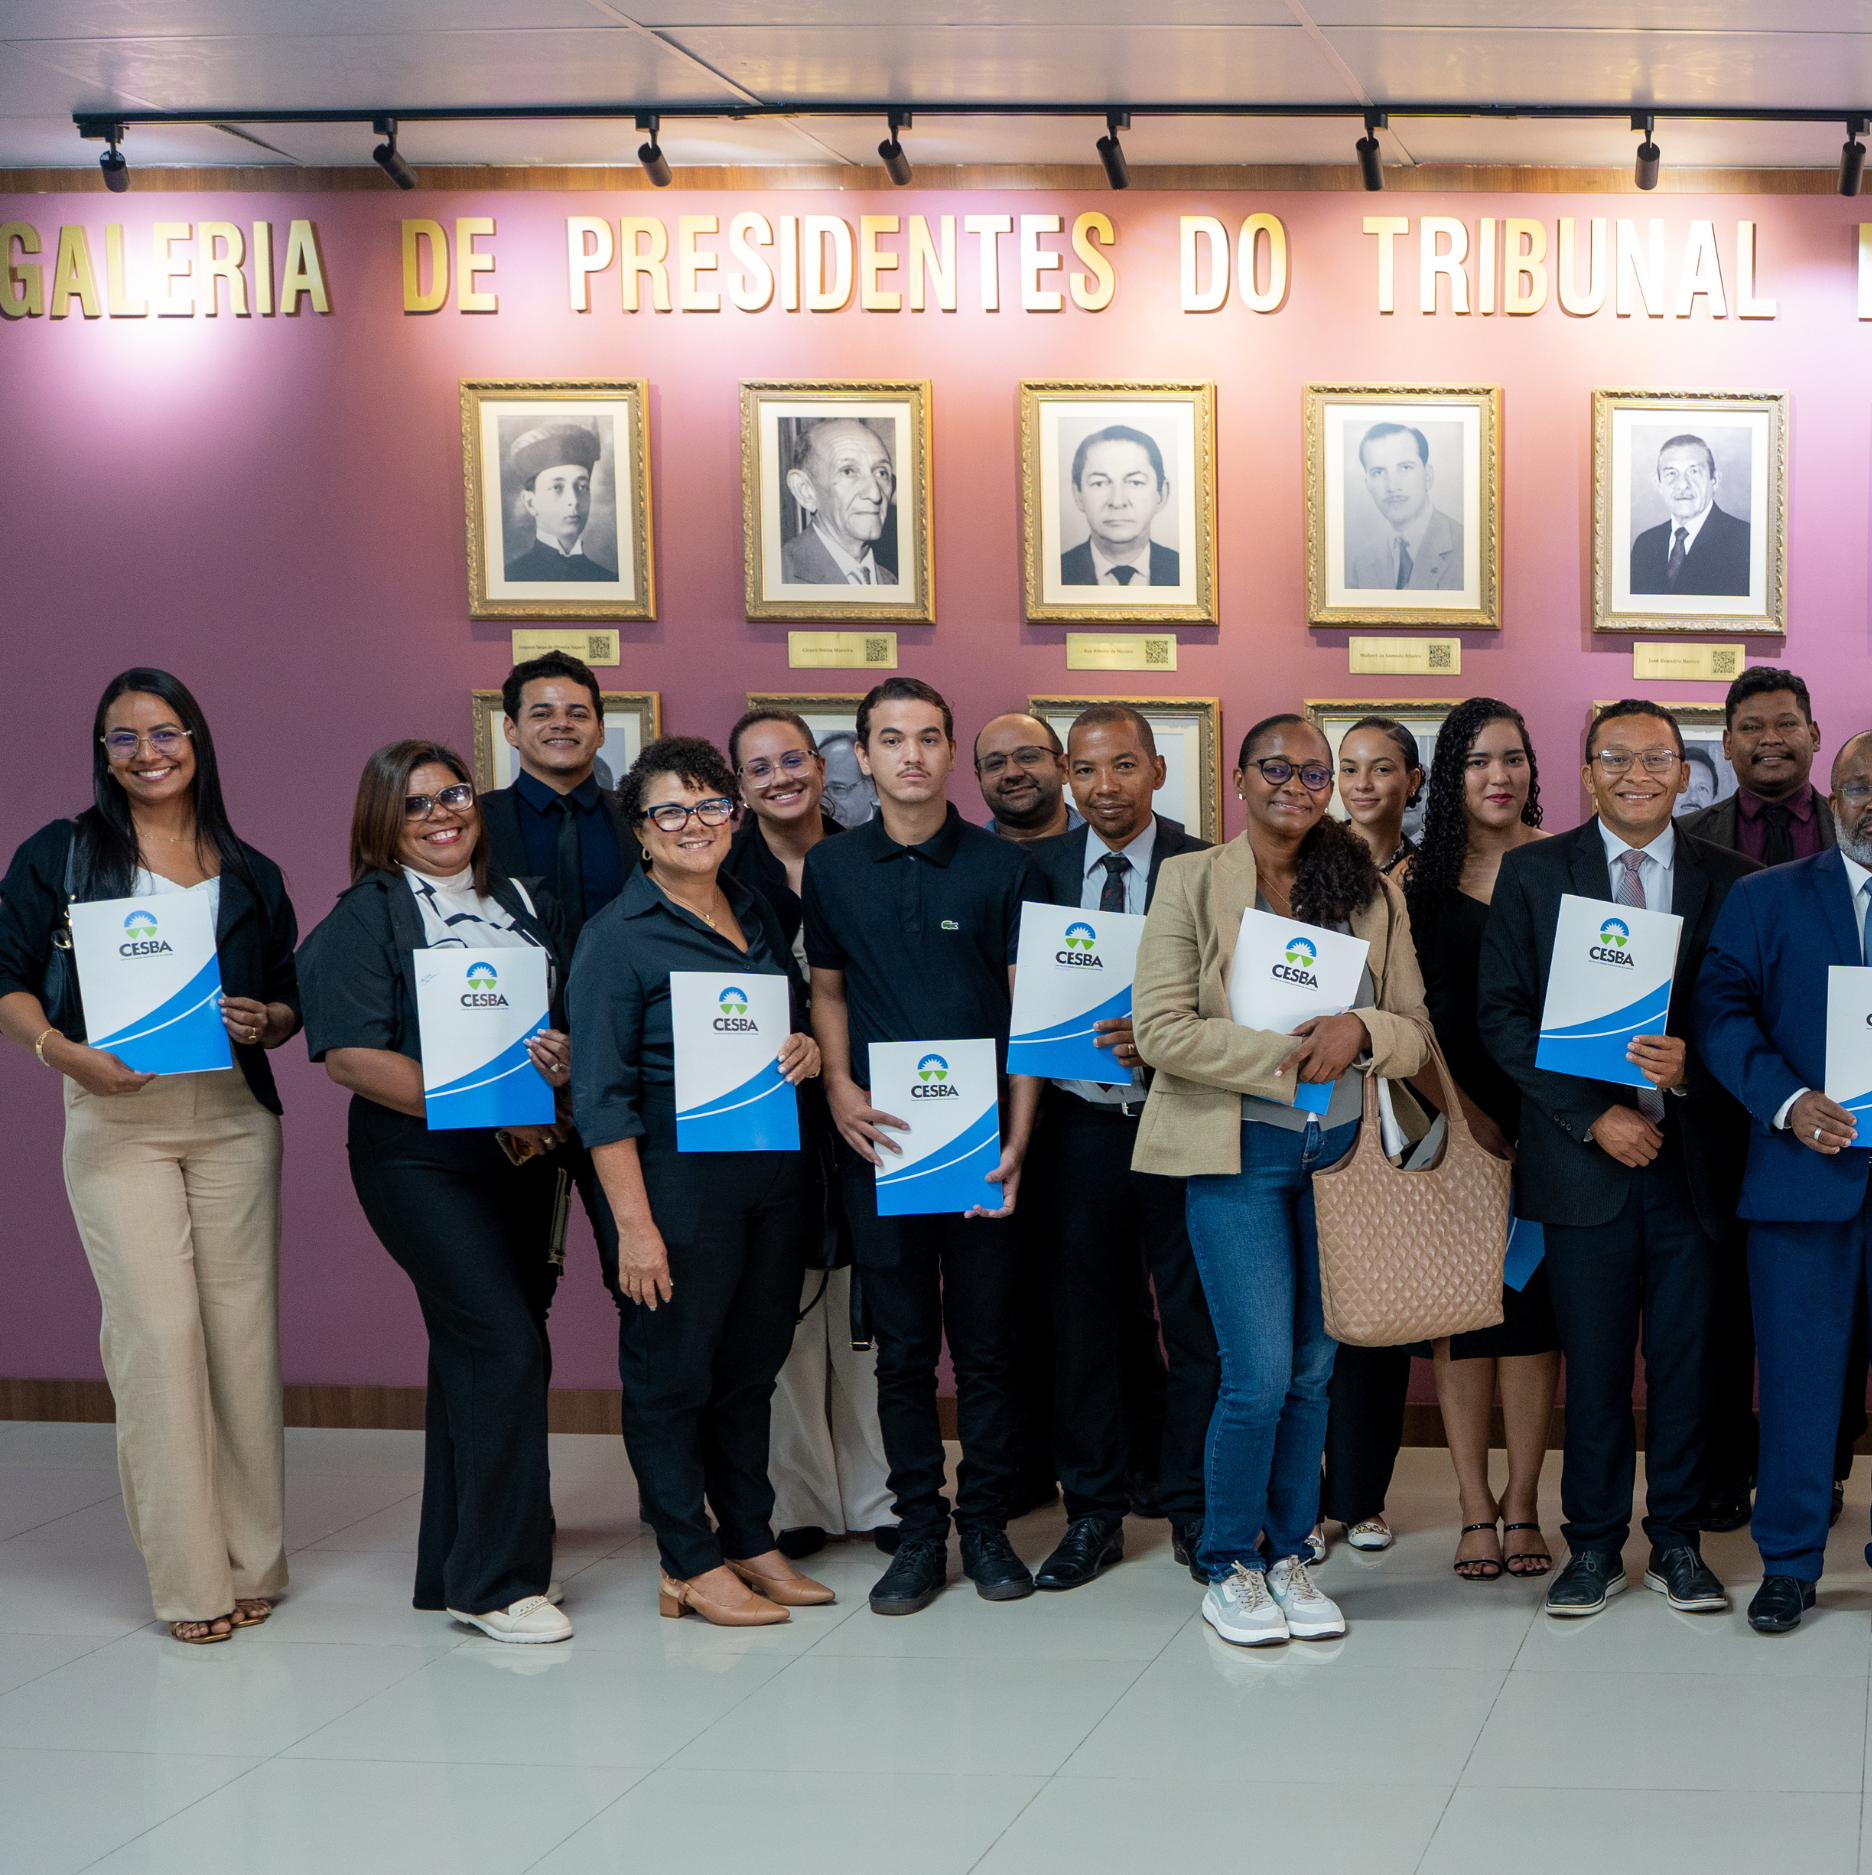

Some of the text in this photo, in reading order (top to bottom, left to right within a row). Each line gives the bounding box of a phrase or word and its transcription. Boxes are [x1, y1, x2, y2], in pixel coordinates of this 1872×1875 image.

[0, 219, 331, 318] GALERIA
[401, 217, 499, 316] DE
[566, 210, 1117, 314] PRESIDENTES
[1178, 212, 1291, 314] DO
[1362, 215, 1779, 320] TRIBUNAL
[119, 939, 173, 957] CESBA
[1589, 946, 1635, 967] CESBA
[1055, 951, 1103, 968] CESBA
[1271, 964, 1318, 989] CESBA
[460, 993, 509, 1007] CESBA
[712, 1017, 759, 1031] CESBA
[910, 1084, 959, 1098] CESBA
